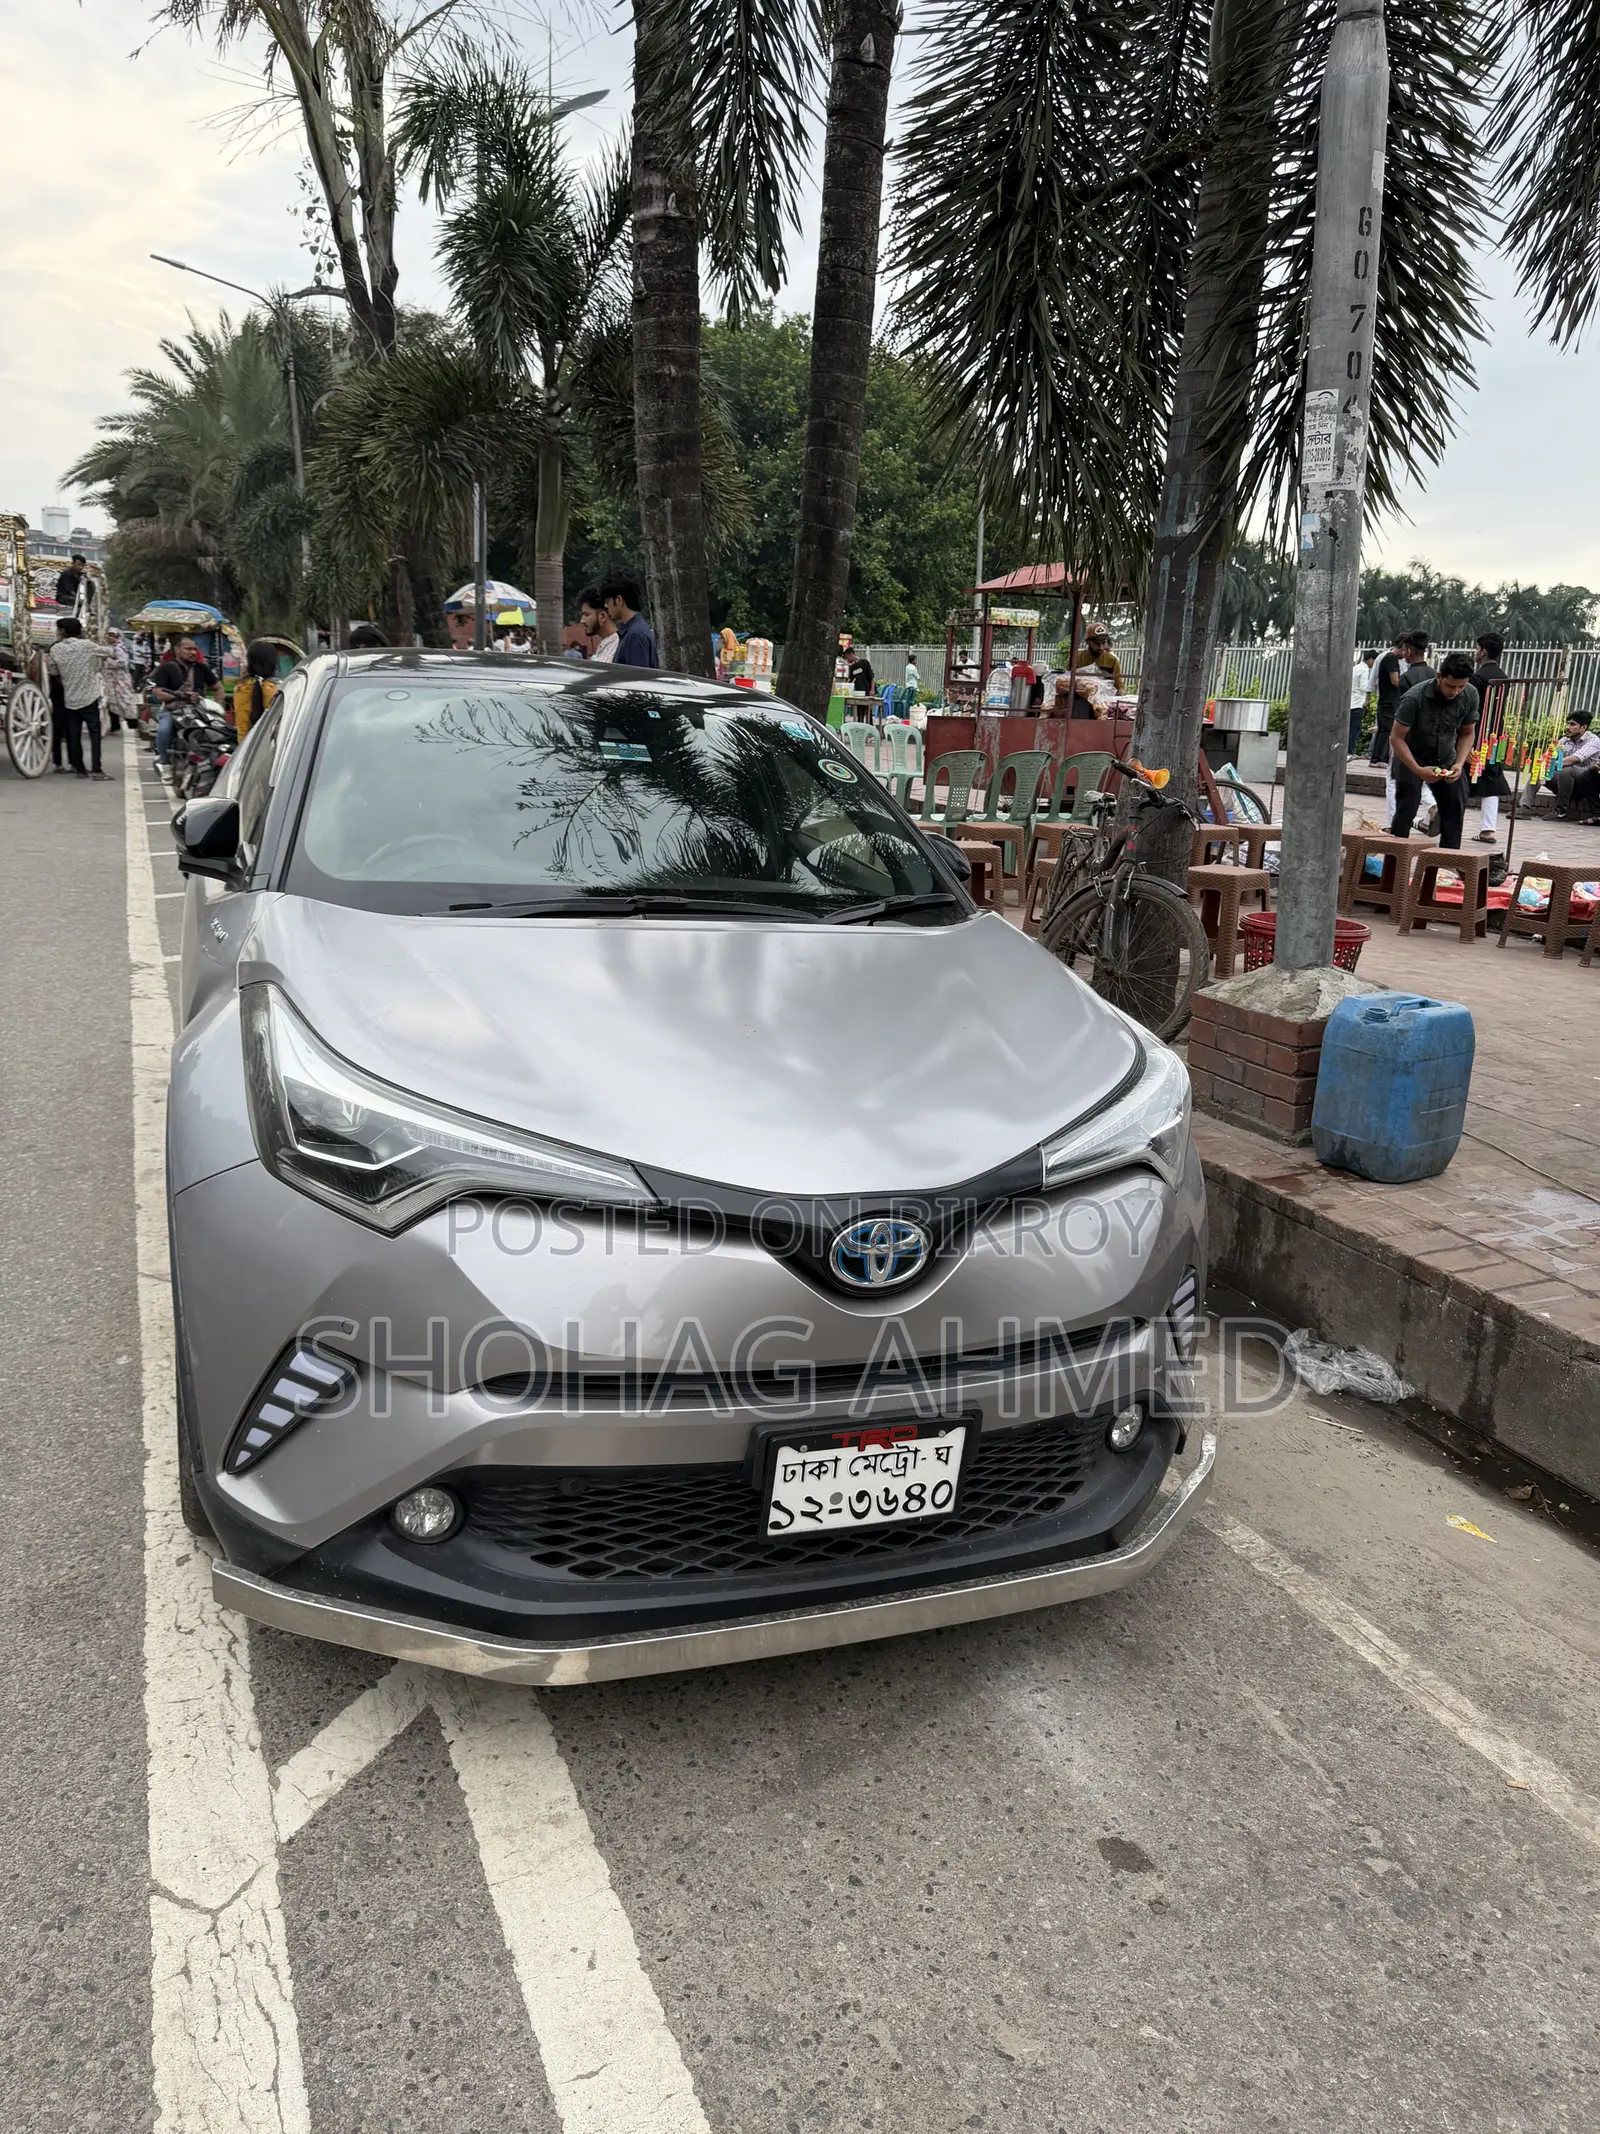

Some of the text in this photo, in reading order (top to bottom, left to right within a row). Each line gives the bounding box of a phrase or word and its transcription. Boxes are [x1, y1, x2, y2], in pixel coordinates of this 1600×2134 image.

[831, 1425, 918, 1451] TRD
[782, 1456, 841, 1483] ঢাকা
[934, 1445, 953, 1466] ঘ
[769, 1479, 953, 1530] ১২-৩৬৪০
